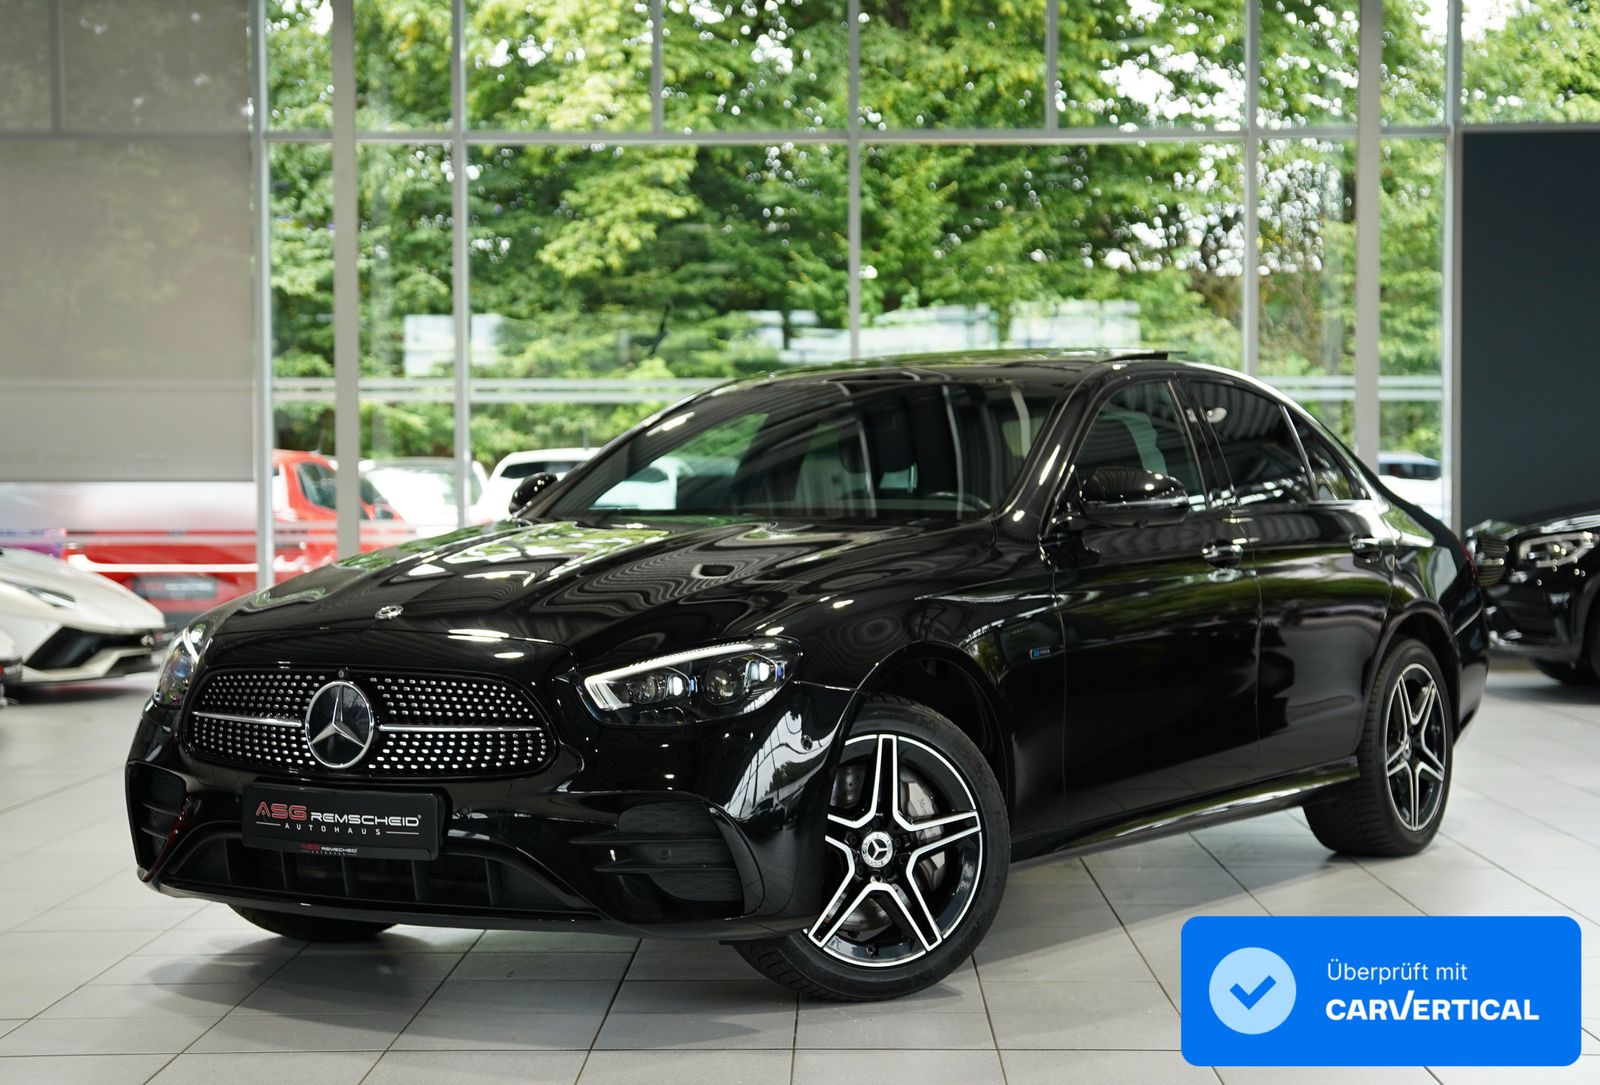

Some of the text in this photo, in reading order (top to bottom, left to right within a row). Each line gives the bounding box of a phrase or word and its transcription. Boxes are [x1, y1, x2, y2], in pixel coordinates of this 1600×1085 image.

[255, 801, 420, 827] ASG REMSCHEID
[284, 822, 381, 836] AUTOHAUS
